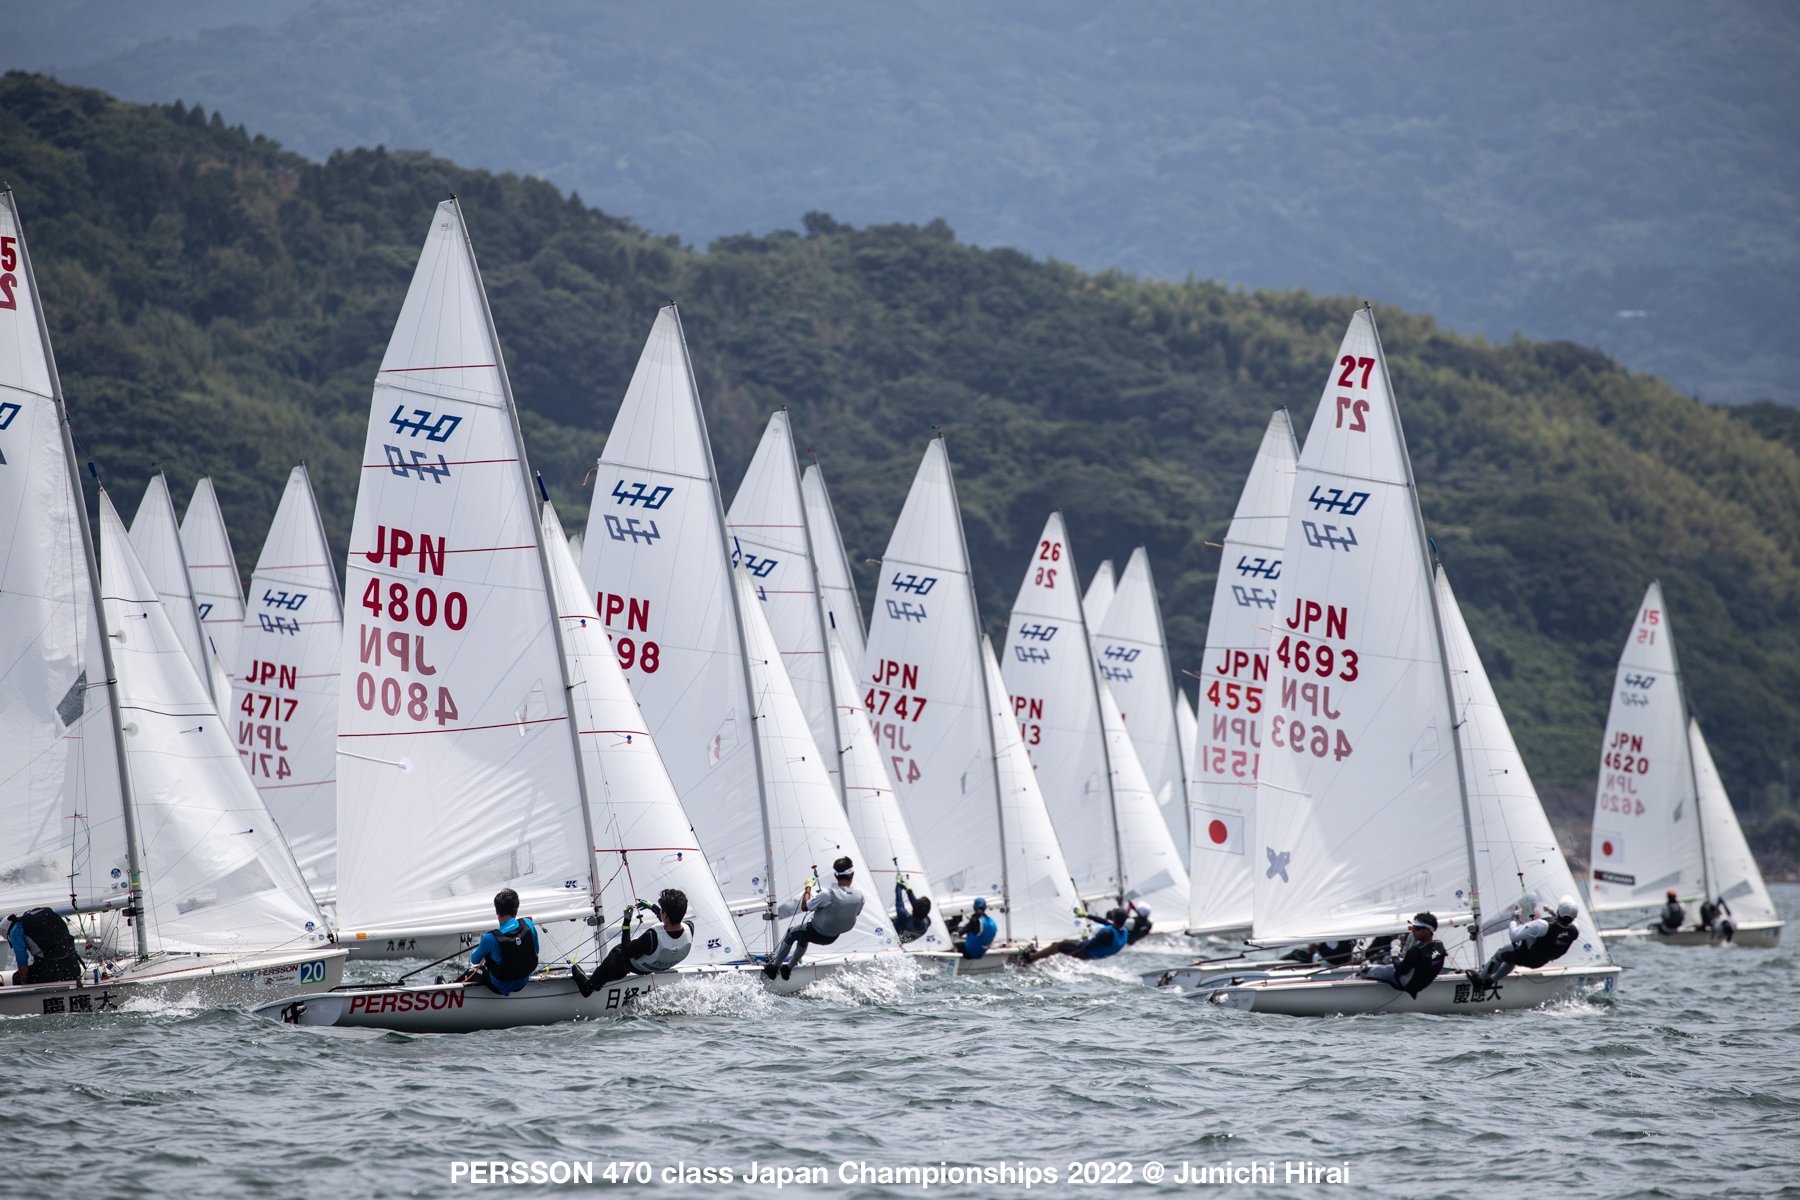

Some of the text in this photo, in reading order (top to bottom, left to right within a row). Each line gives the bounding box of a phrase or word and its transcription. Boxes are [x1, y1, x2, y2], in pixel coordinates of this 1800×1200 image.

[1337, 355, 1375, 390] 27
[389, 404, 463, 443] 470
[611, 480, 674, 510] 470
[1308, 485, 1371, 516] 470
[366, 525, 446, 577] JPN
[1039, 540, 1062, 562] 26
[891, 571, 938, 596] 470
[262, 589, 308, 611] 470
[362, 577, 468, 631] 4800
[1019, 622, 1059, 641] 470
[1286, 598, 1348, 640] JPN
[1642, 608, 1660, 625] 15
[607, 634, 660, 674] 98
[1104, 645, 1142, 663] 470
[1216, 649, 1269, 682] JPN
[1276, 635, 1359, 682] 4693
[244, 659, 297, 690] JPN
[872, 659, 919, 690] JPN
[240, 692, 299, 723] 4717
[864, 688, 927, 723] 4747
[1610, 731, 1643, 753] JPN
[1604, 751, 1649, 775] 4620
[386, 938, 417, 952] 九州大
[302, 961, 324, 984] 20
[348, 989, 466, 1015] PERSSON
